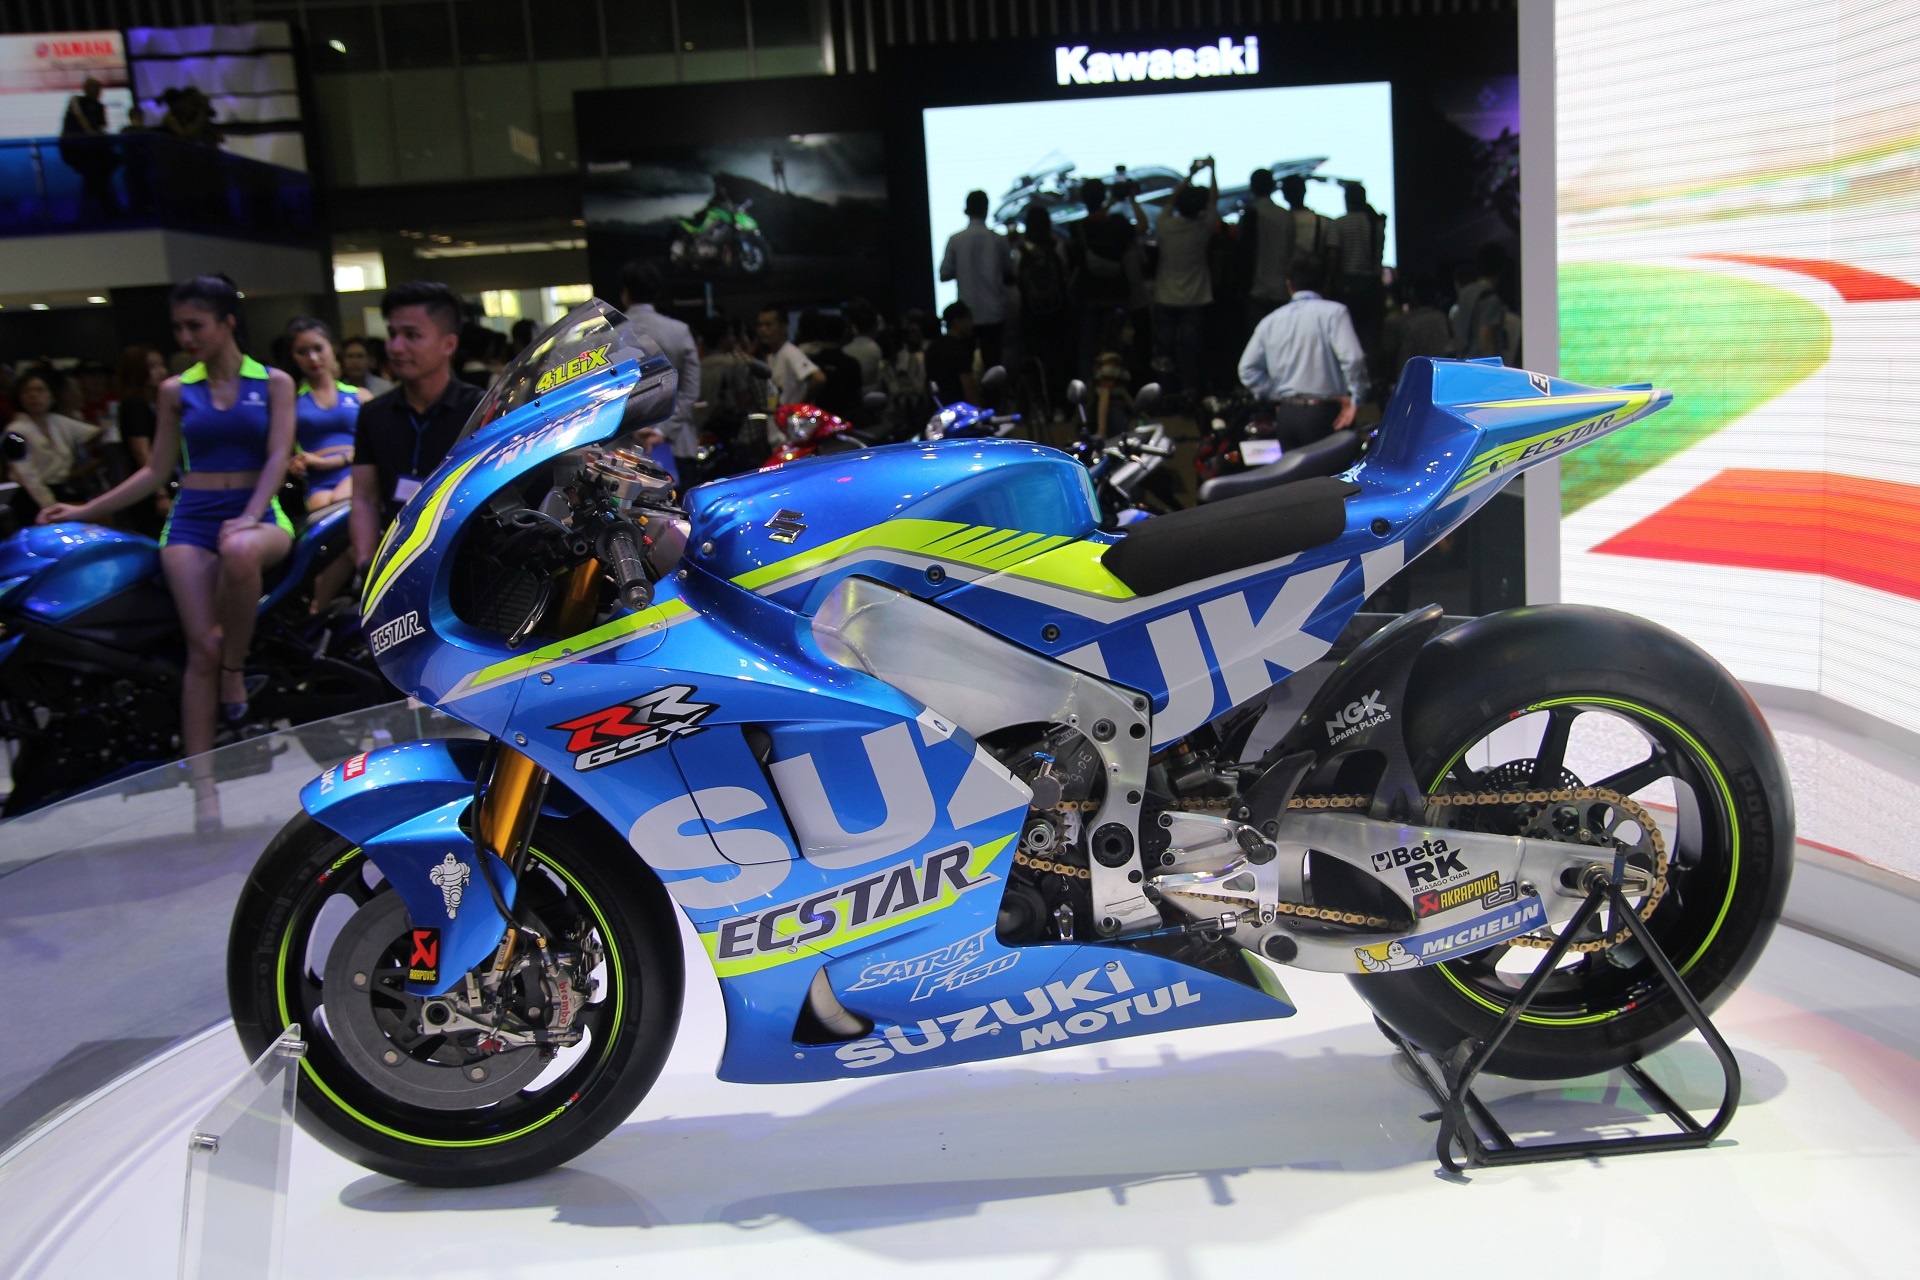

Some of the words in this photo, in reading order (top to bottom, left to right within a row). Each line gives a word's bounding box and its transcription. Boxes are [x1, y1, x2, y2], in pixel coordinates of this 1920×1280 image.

[1055, 35, 1259, 86] Kawasaki
[1517, 413, 1616, 461] ECSTAR
[370, 610, 426, 657] ECSTAR
[1325, 689, 1387, 738] NGK
[1330, 726, 1359, 746] SPARK
[1359, 711, 1392, 730] PLUGS
[1391, 839, 1449, 867] Beta
[1404, 848, 1468, 888] RK
[716, 842, 997, 961] ECSTAR
[1412, 878, 1448, 894] TAKASAGO
[1449, 870, 1470, 882] CHAIN
[1421, 903, 1539, 956] MICHELIN
[845, 923, 997, 992] SATRIA
[559, 981, 571, 1025] brembo
[835, 959, 1135, 1068] SUZUKI
[1020, 980, 1201, 1051] MOTUL
